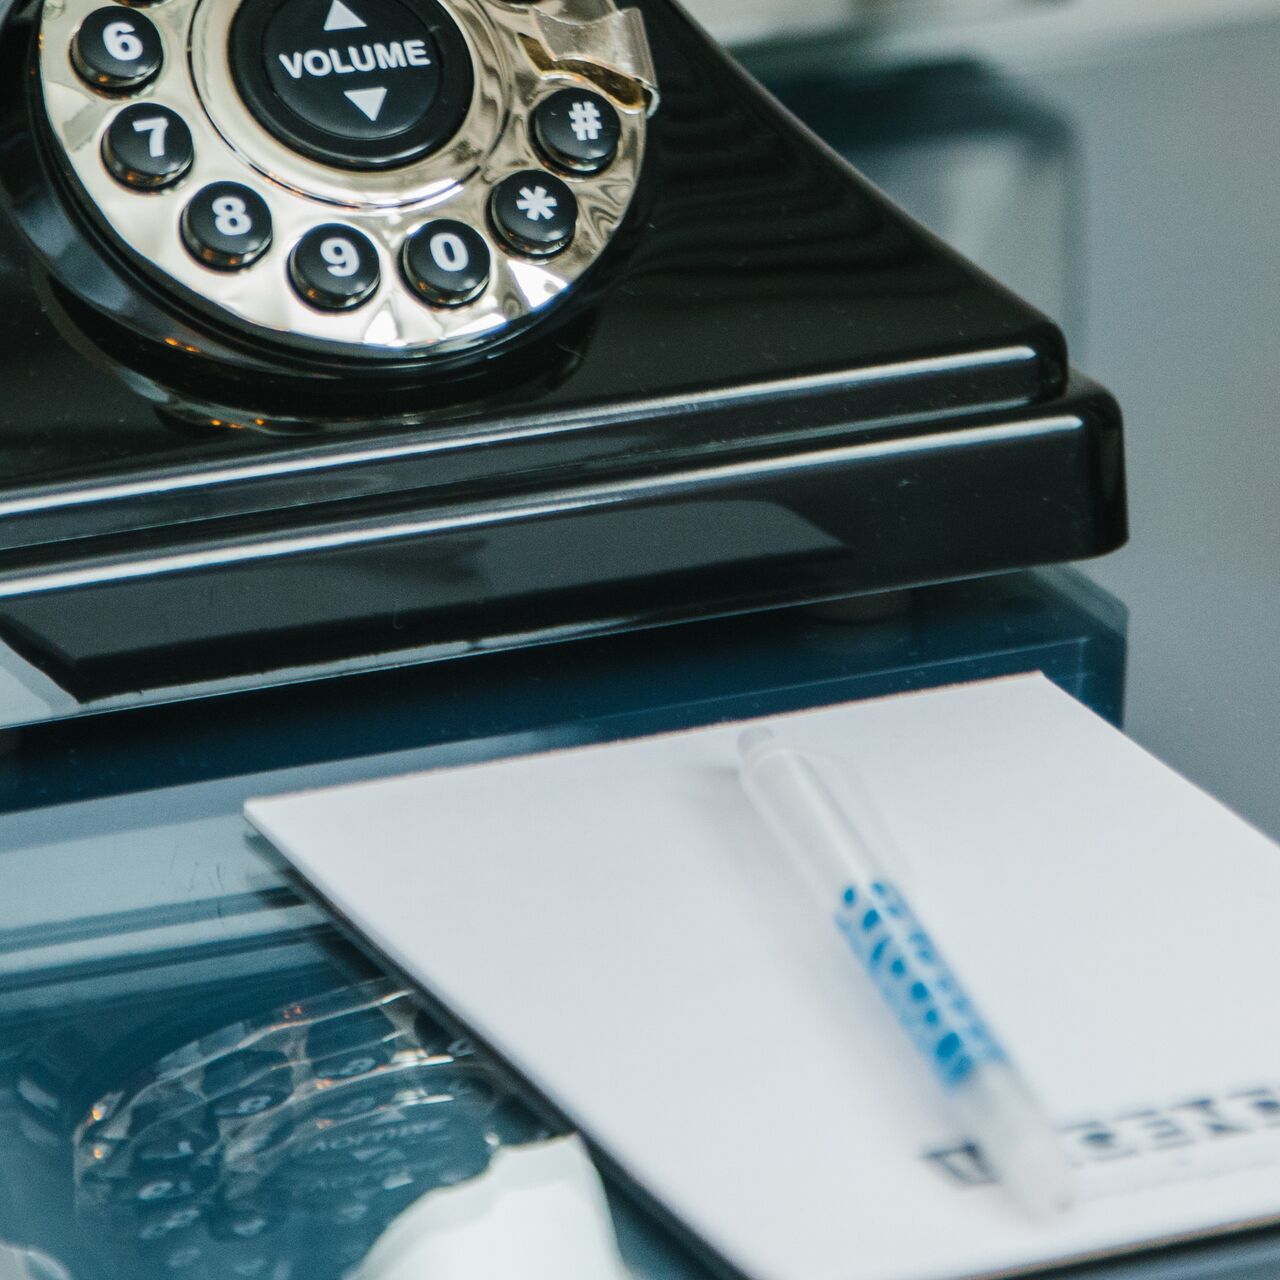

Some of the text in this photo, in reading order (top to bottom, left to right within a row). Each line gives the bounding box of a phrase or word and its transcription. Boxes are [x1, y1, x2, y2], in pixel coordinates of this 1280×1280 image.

[103, 22, 144, 61] 6
[278, 39, 431, 79] VOLUME
[132, 117, 169, 158] 7
[568, 101, 602, 141] #
[212, 196, 252, 236] 8
[320, 237, 360, 277] 9
[429, 232, 469, 272] 0
